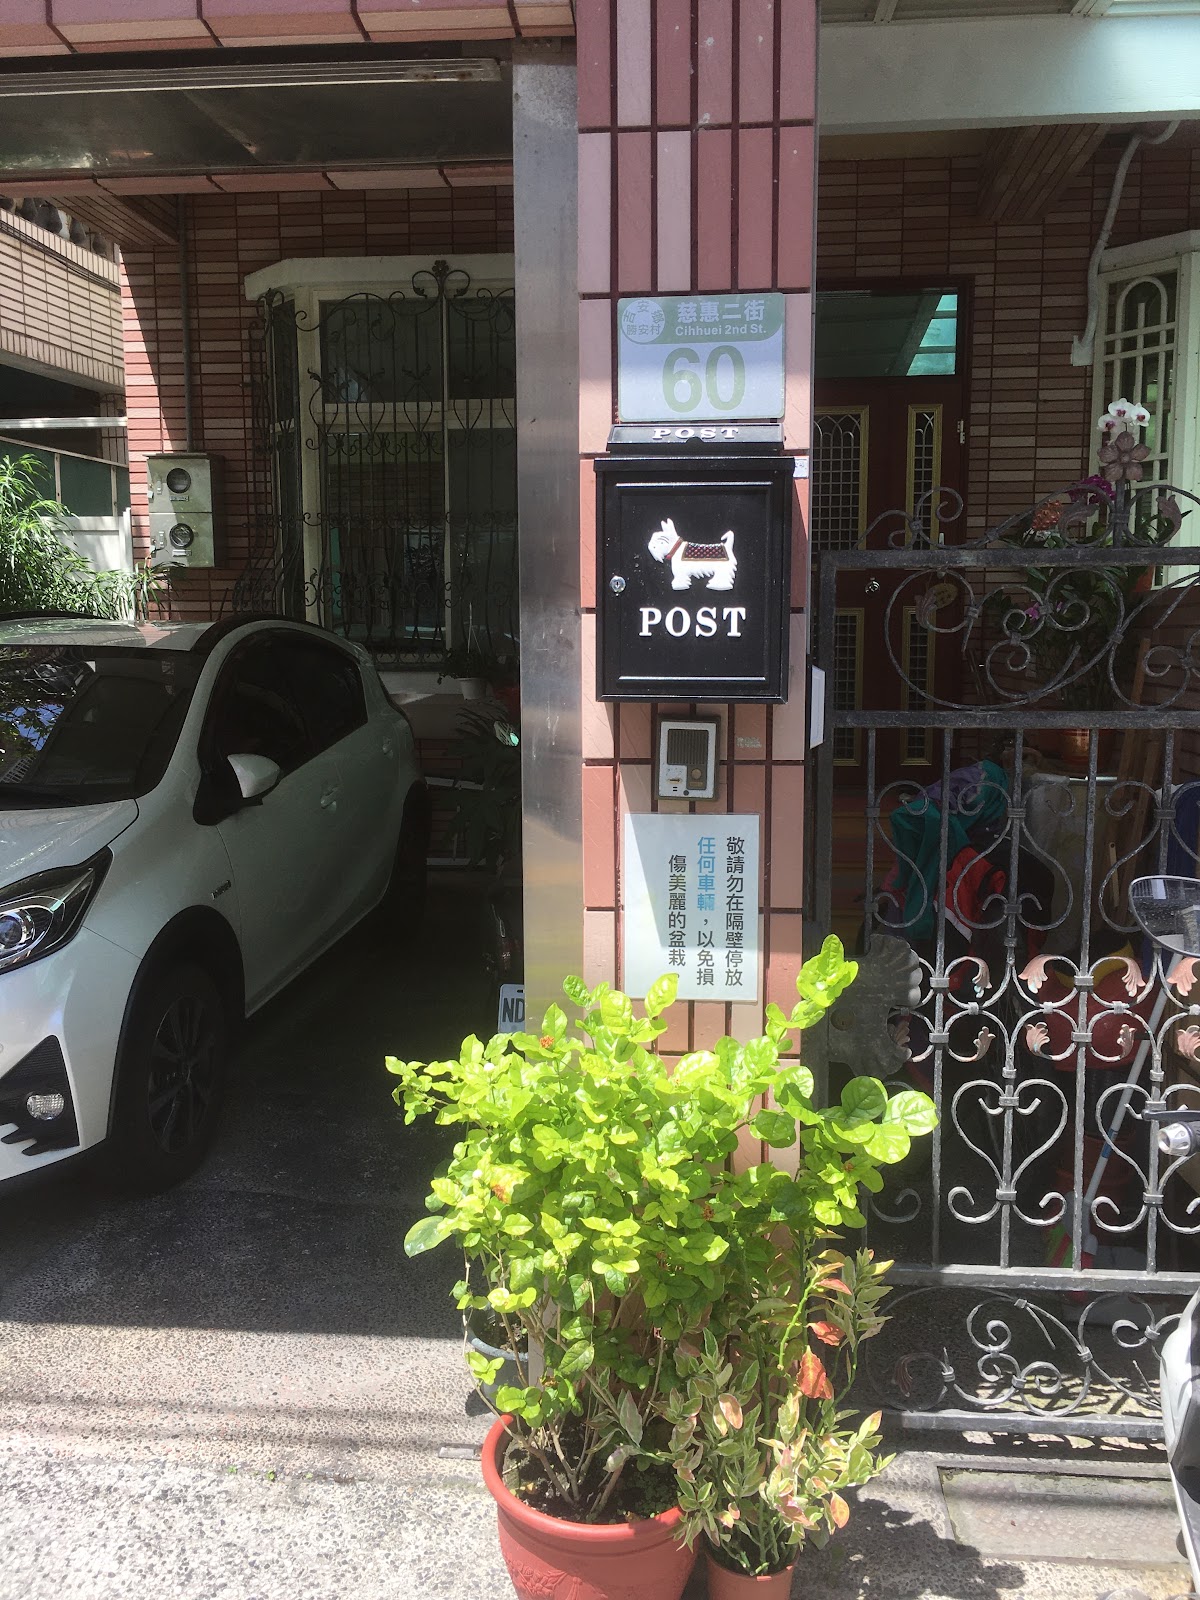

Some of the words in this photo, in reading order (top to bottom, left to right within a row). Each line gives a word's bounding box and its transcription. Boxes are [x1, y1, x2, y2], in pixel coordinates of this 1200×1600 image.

[677, 300, 765, 323] 慈惠二街
[626, 324, 661, 336] 勝安村
[675, 324, 722, 336] Cihhuei
[725, 324, 747, 335] 2nd
[750, 323, 767, 334] St.
[662, 345, 746, 413] 60
[652, 428, 739, 440] POST
[638, 607, 746, 638] POST
[668, 854, 687, 978] 傷美麗的盆栽
[725, 836, 745, 987] 敬請勿在隔壁停放
